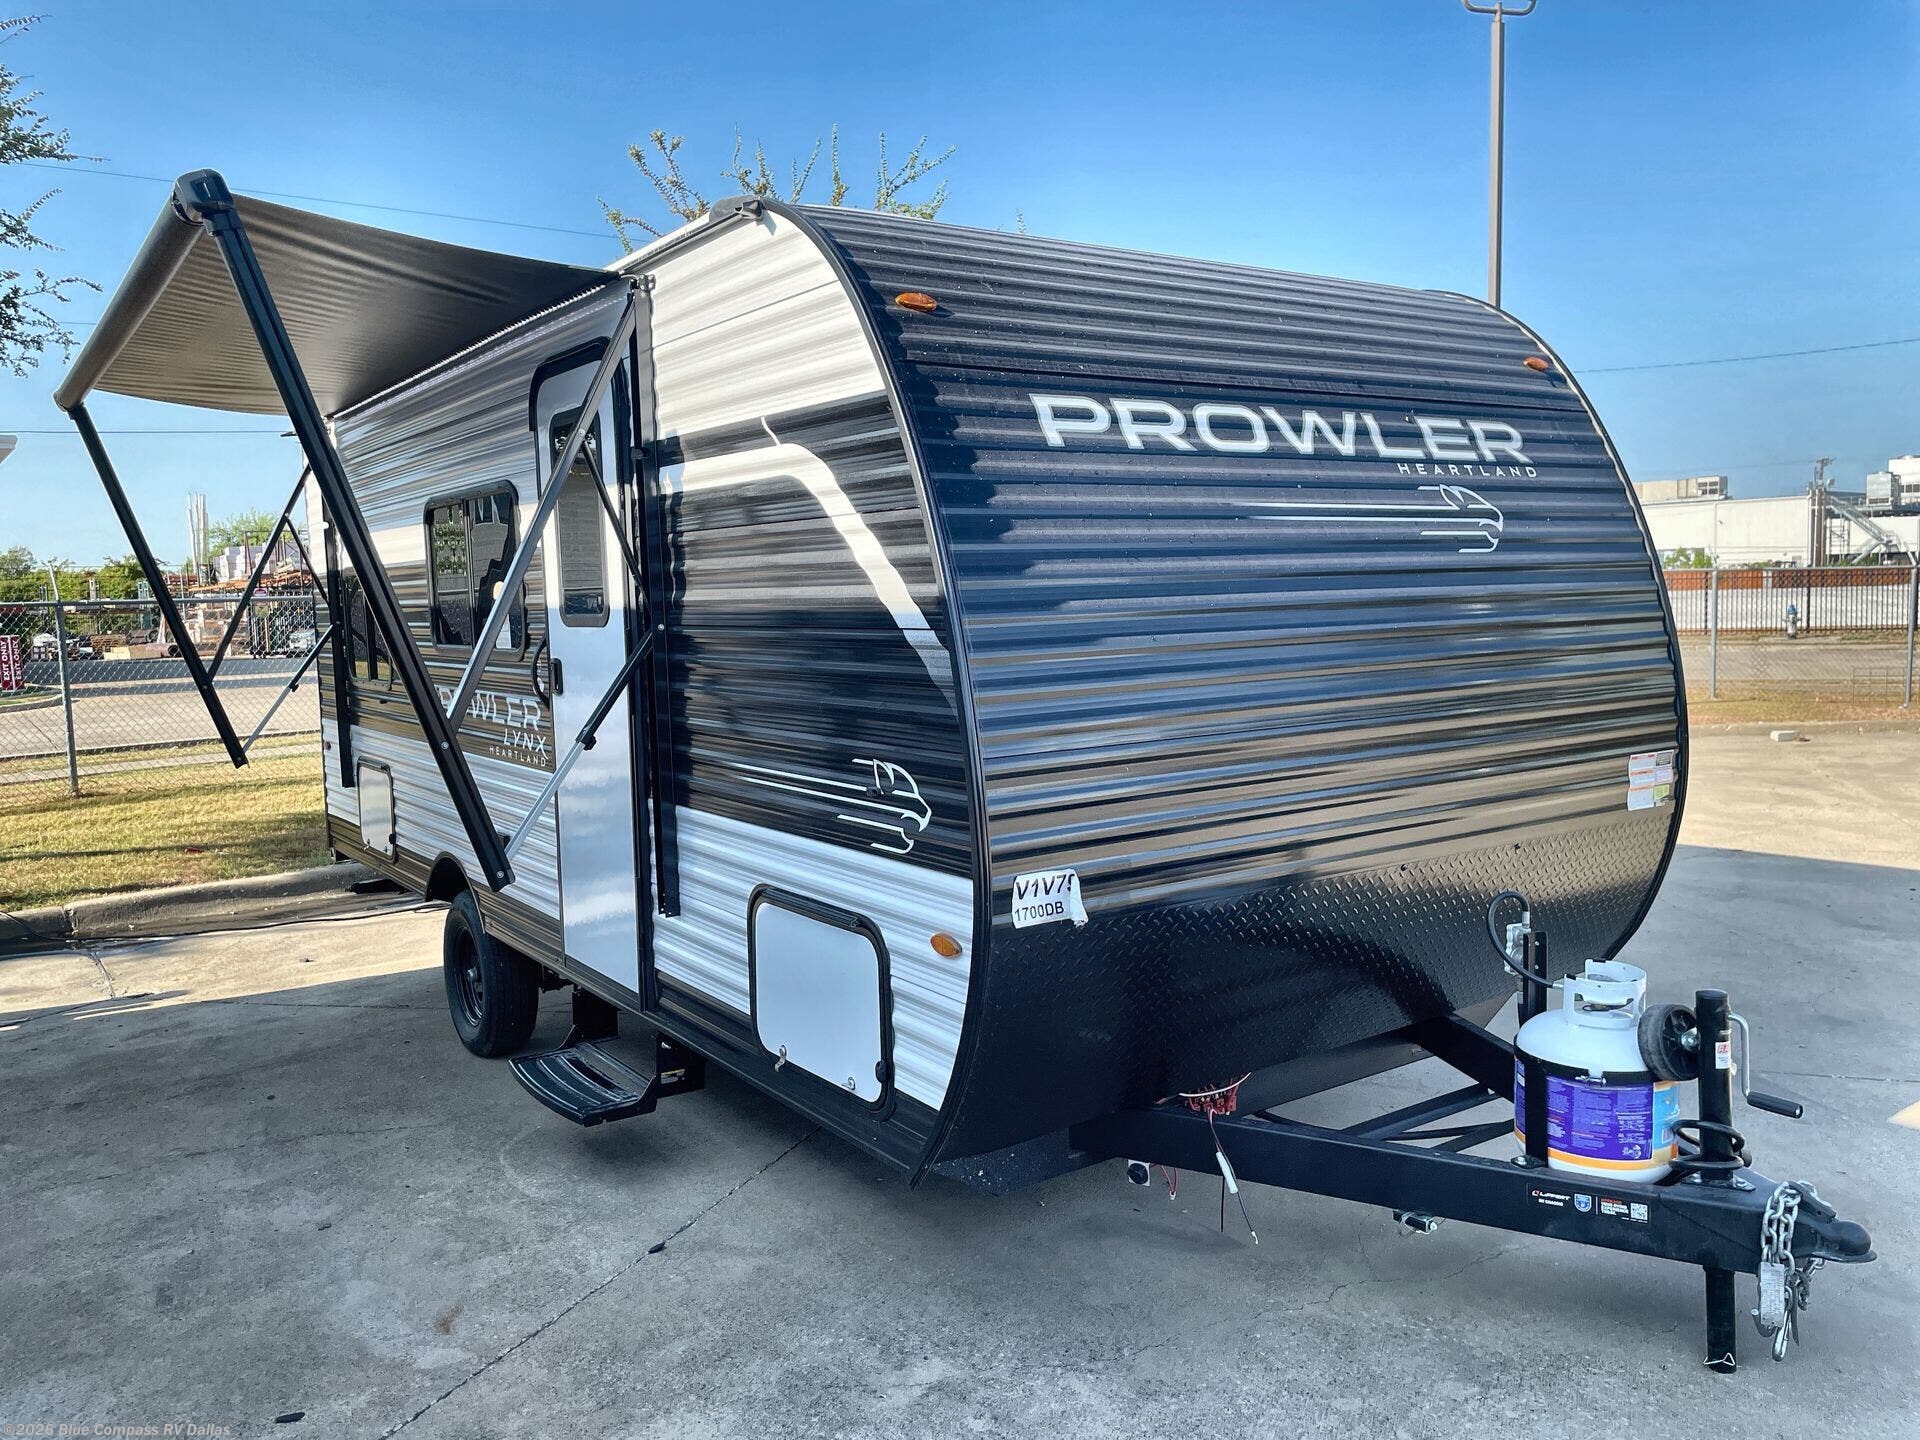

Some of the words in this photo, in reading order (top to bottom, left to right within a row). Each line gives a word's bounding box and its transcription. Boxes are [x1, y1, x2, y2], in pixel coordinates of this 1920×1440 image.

[1028, 393, 1534, 463] PROWLER
[1396, 462, 1538, 478] HEARTLAND
[0, 640, 8, 662] ONLY
[3, 662, 11, 681] EXIT
[14, 662, 22, 680] EXIT
[503, 728, 548, 760] LYNX
[489, 745, 547, 767] HEARTLAND
[1014, 901, 1065, 922] 1700DB
